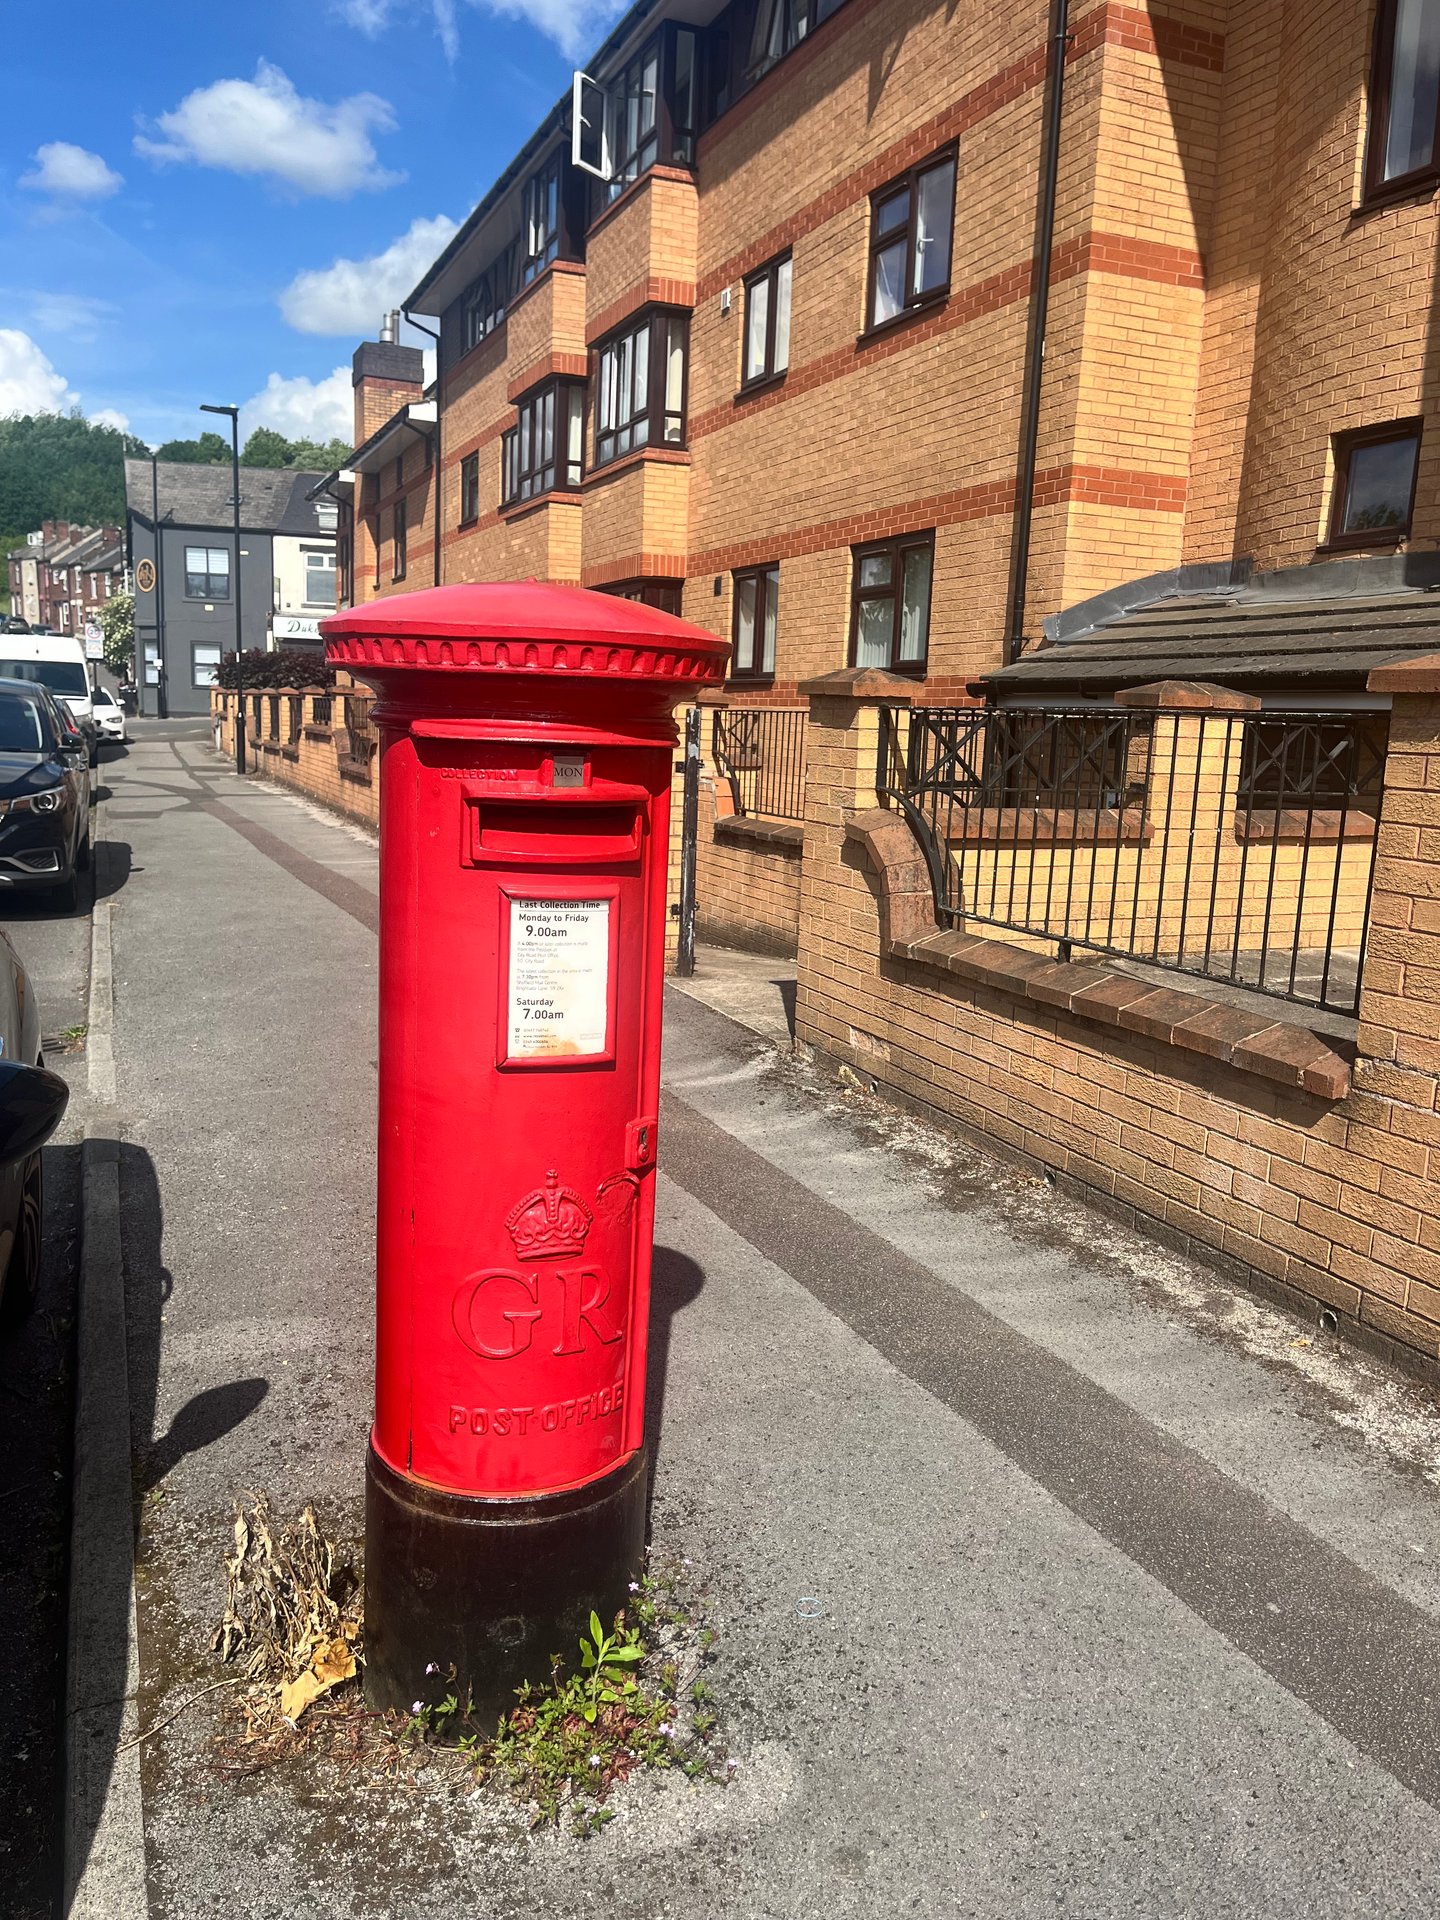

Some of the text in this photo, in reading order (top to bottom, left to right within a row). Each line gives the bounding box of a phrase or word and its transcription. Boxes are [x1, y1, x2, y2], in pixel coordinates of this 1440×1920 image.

[440, 767, 519, 781] COLLECTION
[554, 767, 583, 777] MON
[519, 901, 600, 909] Last Collection Time
[519, 914, 552, 923] Monday
[565, 914, 589, 923] Friday
[525, 925, 567, 937] 9.00am
[516, 997, 554, 1006] Saturday
[522, 1008, 564, 1020] 7.00am
[452, 1265, 623, 1361] GR
[449, 1379, 624, 1436] POST OFFICE
